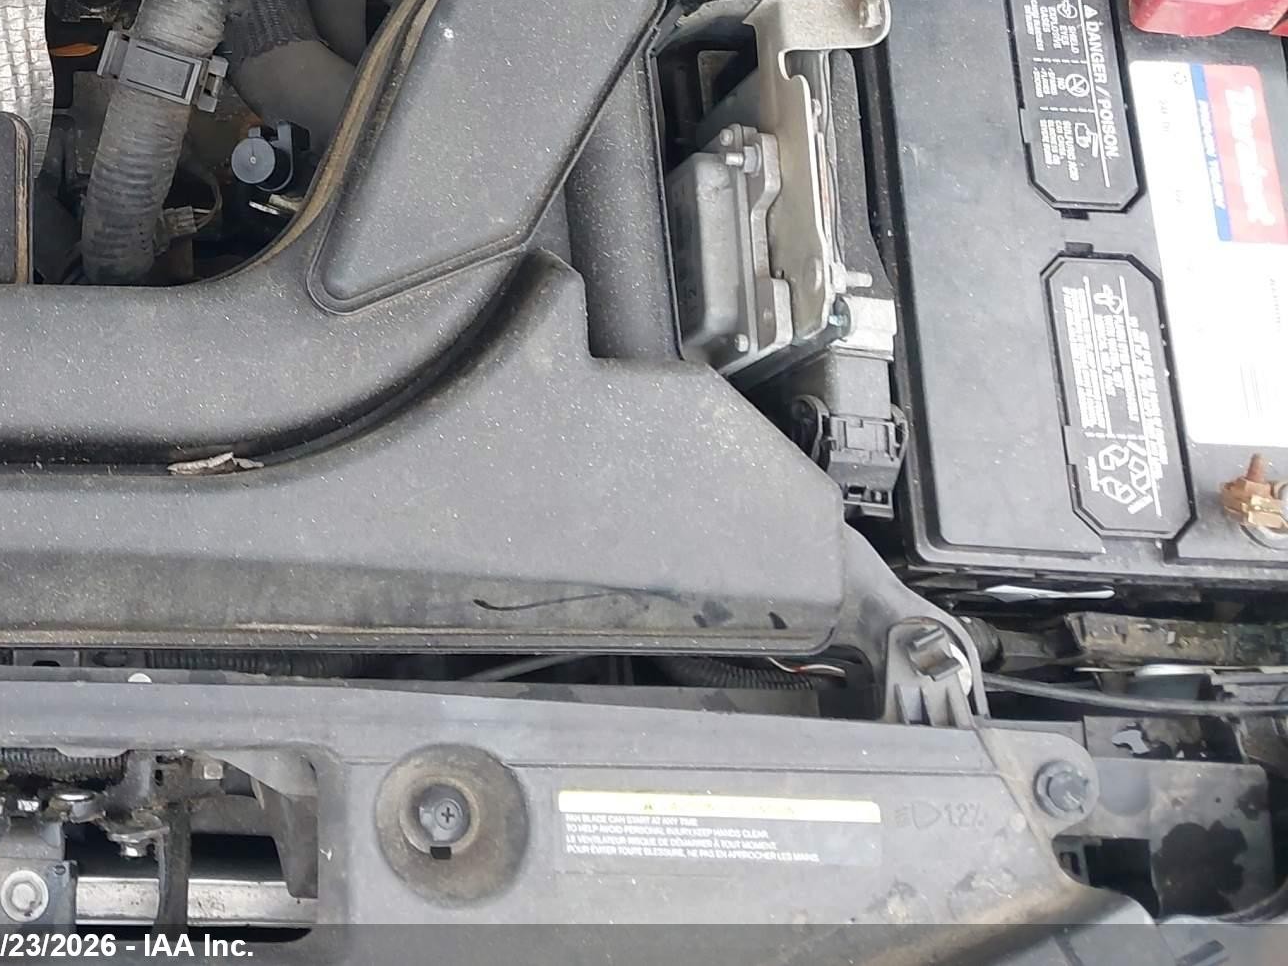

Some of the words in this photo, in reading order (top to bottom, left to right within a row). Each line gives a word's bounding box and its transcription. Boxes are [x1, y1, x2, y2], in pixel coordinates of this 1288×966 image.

[1039, 6, 1050, 32] GASES
[1047, 6, 1061, 48] EXPLOSIVE
[1068, 25, 1079, 53] SHIELD
[1086, 21, 1107, 83] DANGER
